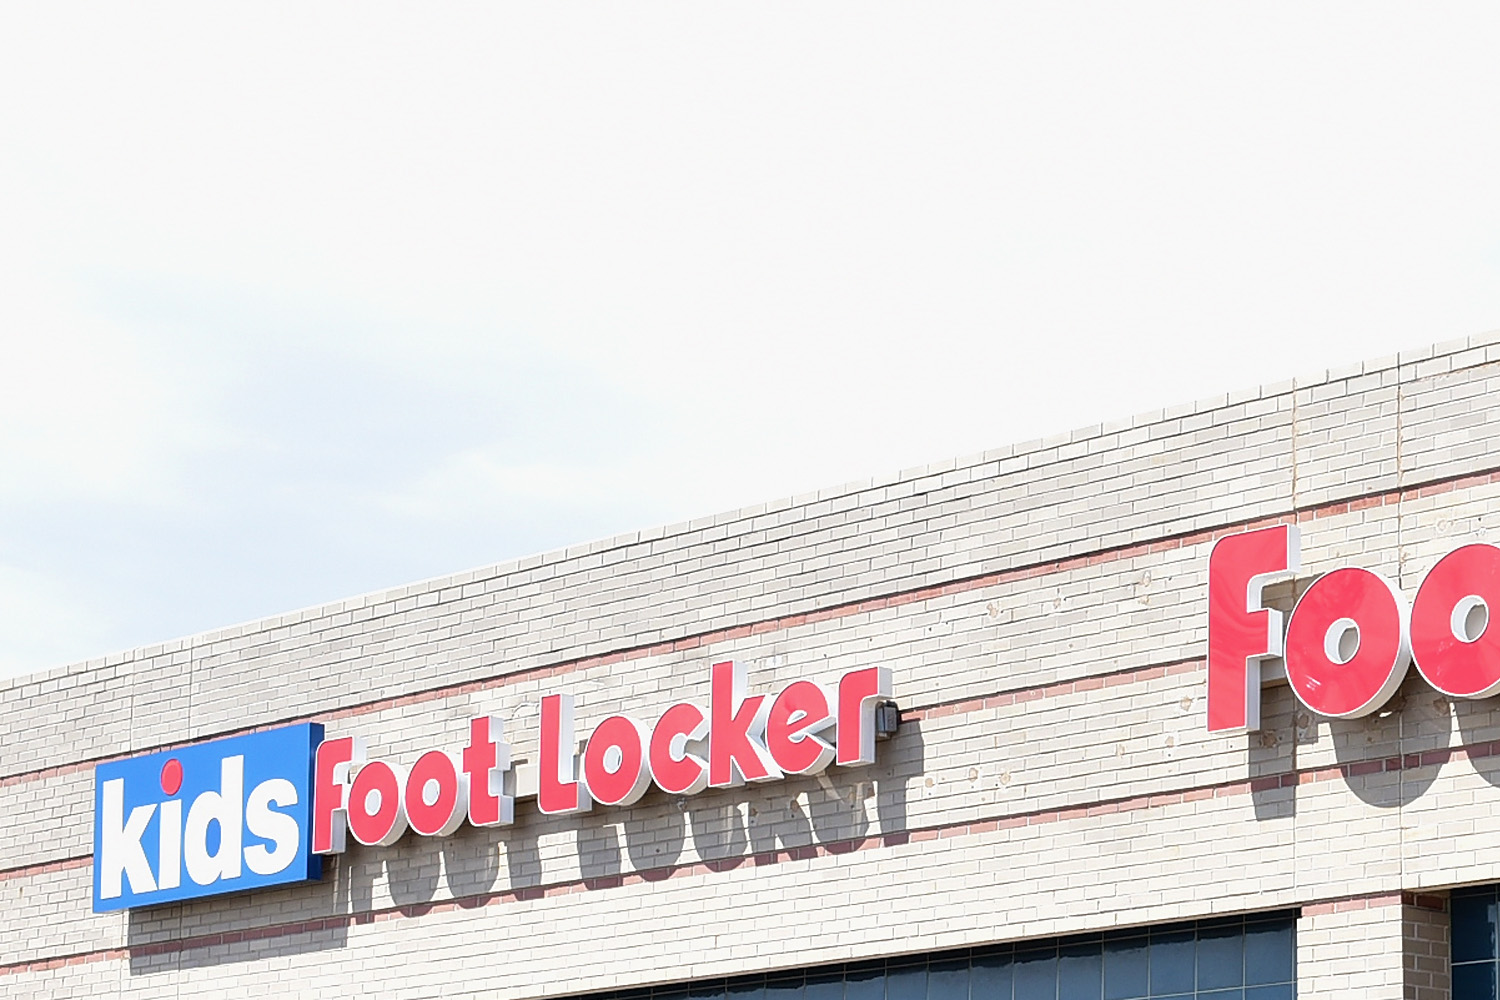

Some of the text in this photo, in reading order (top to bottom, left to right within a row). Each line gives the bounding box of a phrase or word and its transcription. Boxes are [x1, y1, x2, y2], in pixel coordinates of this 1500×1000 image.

[100, 660, 892, 900] kids Foot Locker
